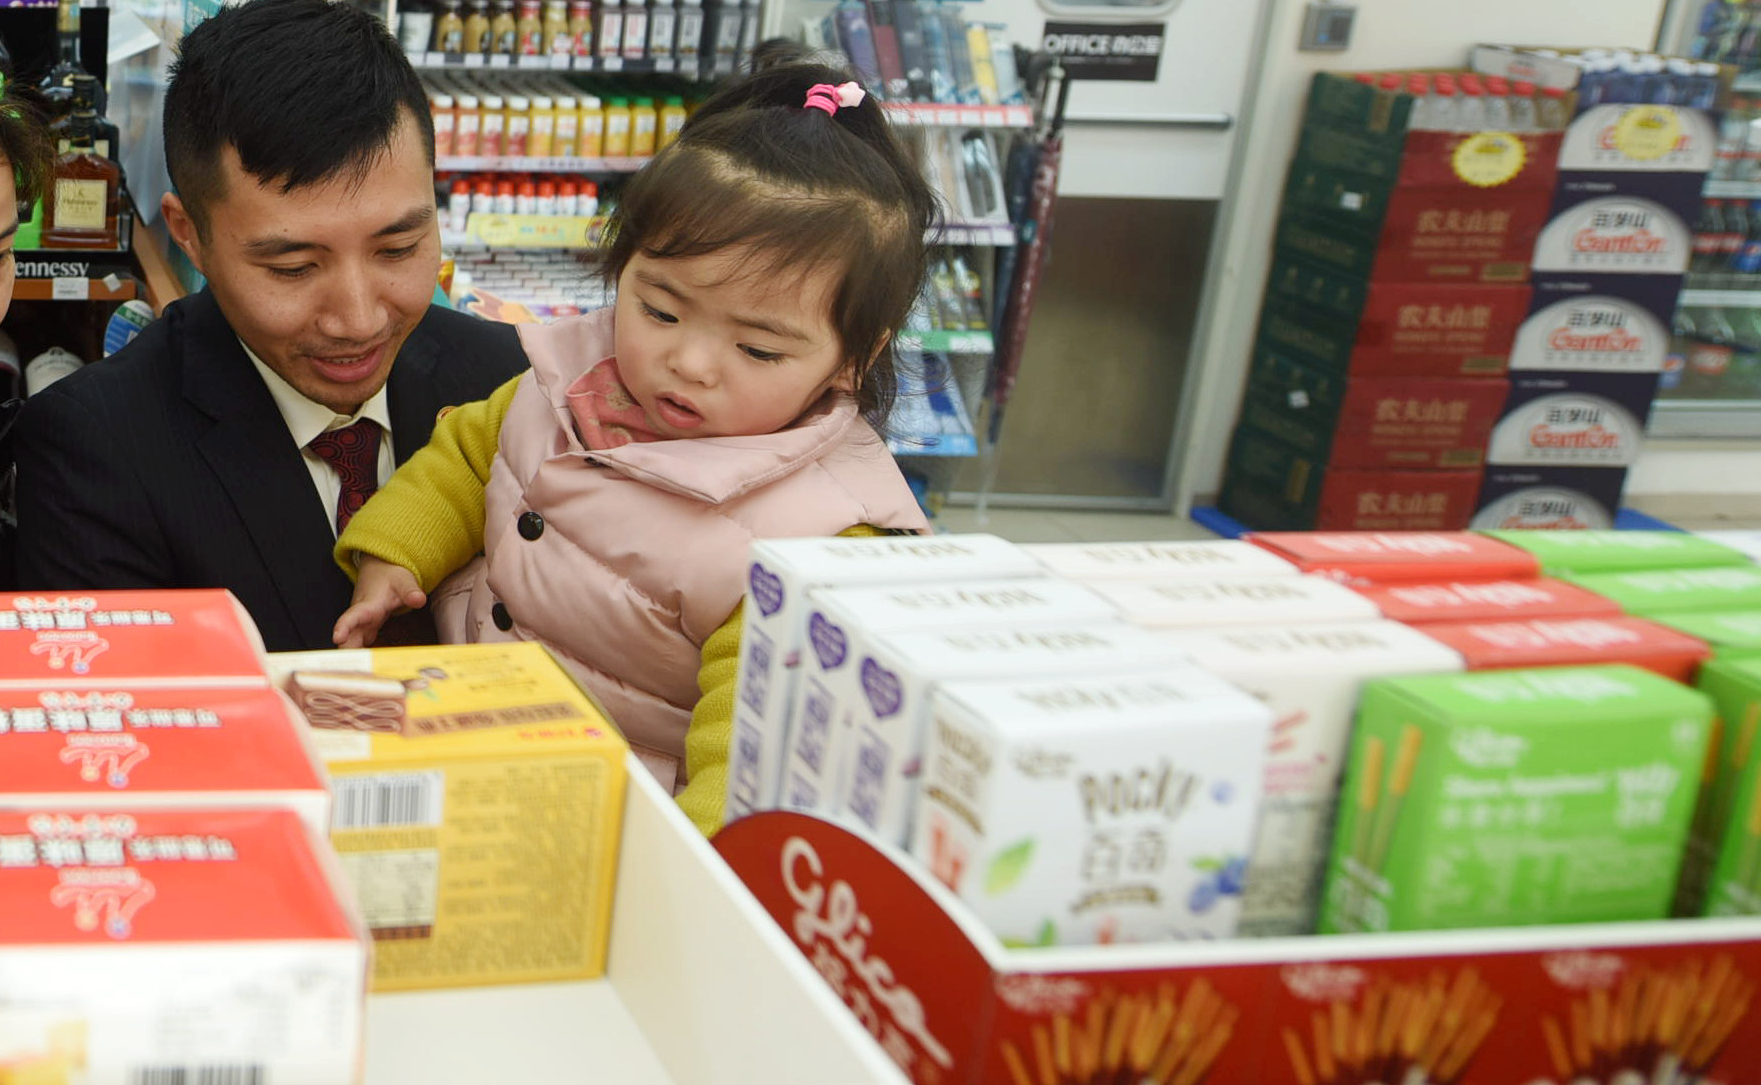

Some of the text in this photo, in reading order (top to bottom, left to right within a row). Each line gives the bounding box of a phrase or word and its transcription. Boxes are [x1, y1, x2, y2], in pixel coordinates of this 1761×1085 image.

[1044, 34, 1109, 54] OFFICE
[14, 259, 90, 278] ennessy
[781, 836, 954, 1069] Glico
